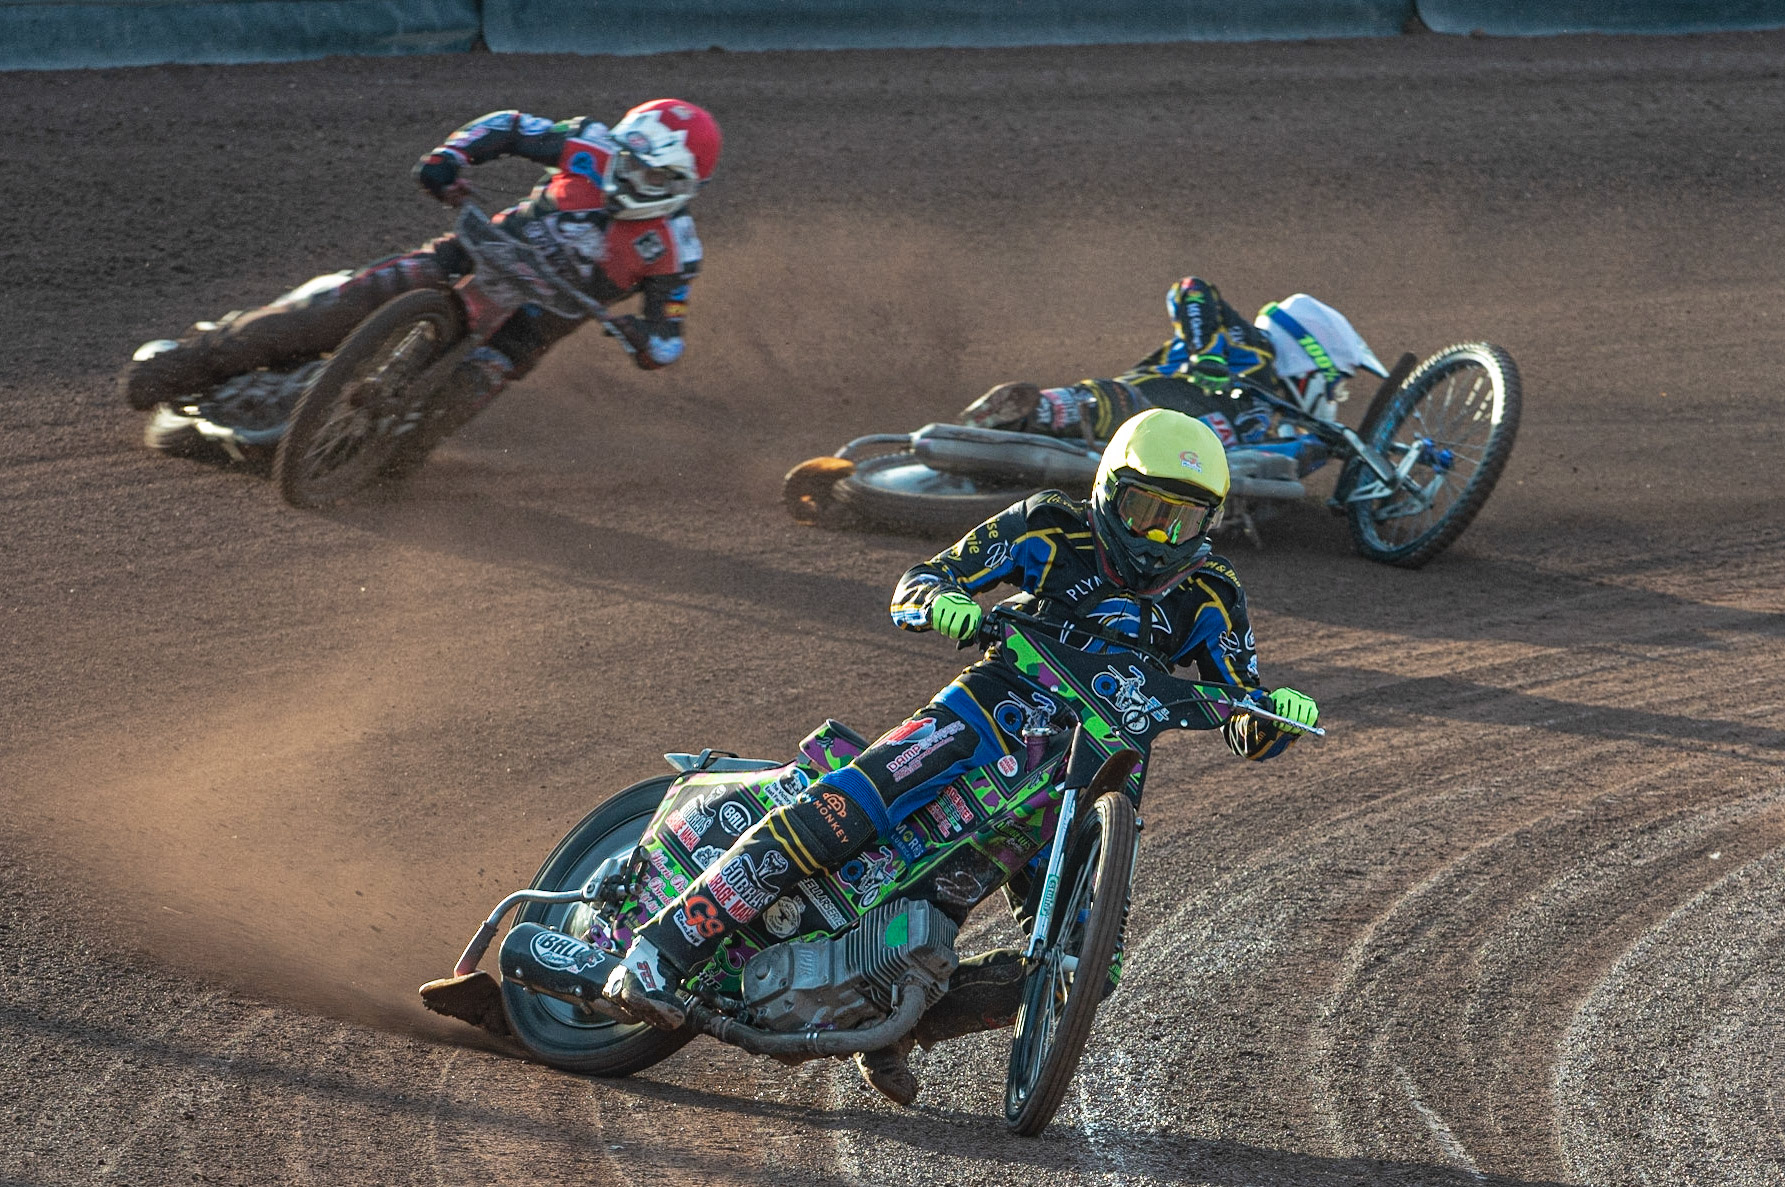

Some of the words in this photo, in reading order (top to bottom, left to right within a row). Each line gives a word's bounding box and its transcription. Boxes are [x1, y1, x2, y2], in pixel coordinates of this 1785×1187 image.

[723, 807, 747, 832] BALL
[813, 800, 848, 843] MONKEY
[706, 873, 736, 906] ARAGE
[721, 856, 777, 909] COBRAS
[675, 911, 699, 943] Racing
